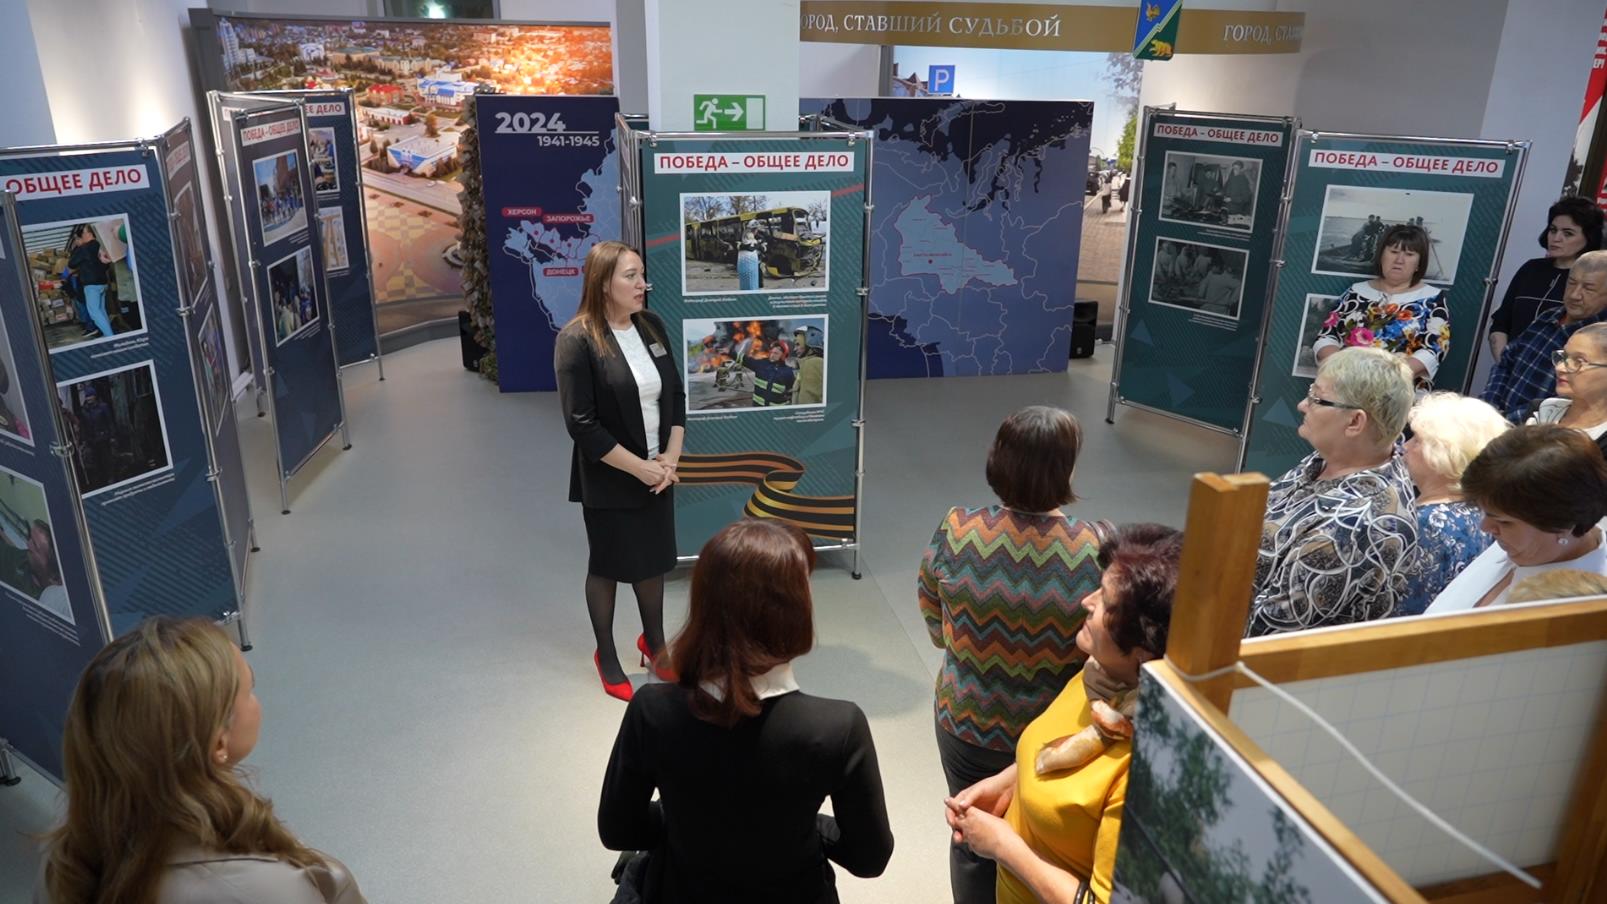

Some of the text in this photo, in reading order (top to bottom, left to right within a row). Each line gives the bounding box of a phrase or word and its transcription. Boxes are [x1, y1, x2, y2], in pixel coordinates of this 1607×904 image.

[801, 12, 1062, 37] ОРОД, СТАВШИЙ СУДЬБОЙ
[316, 103, 342, 115] ДЕЛО
[495, 112, 566, 132] 2024
[537, 135, 600, 147] 1941-1945
[1157, 124, 1198, 137] ПОБЕДА
[1207, 128, 1245, 141] ОБЩЕЕ
[1247, 131, 1279, 143] ДЕЛО
[660, 155, 728, 171] ПОБЕДА
[744, 154, 801, 170] ОБЩЕЕ
[804, 154, 849, 170] ДЕЛО
[1314, 152, 1378, 168] ПОБЕДА
[1393, 156, 1449, 171] ОБЩЕЕ
[1452, 159, 1498, 174] ДЕЛО
[6, 168, 141, 195] ОБЩЕЕ ДЕЛО
[507, 208, 537, 216] ХЕРСОН
[546, 268, 575, 276] ДОНЕЦК
